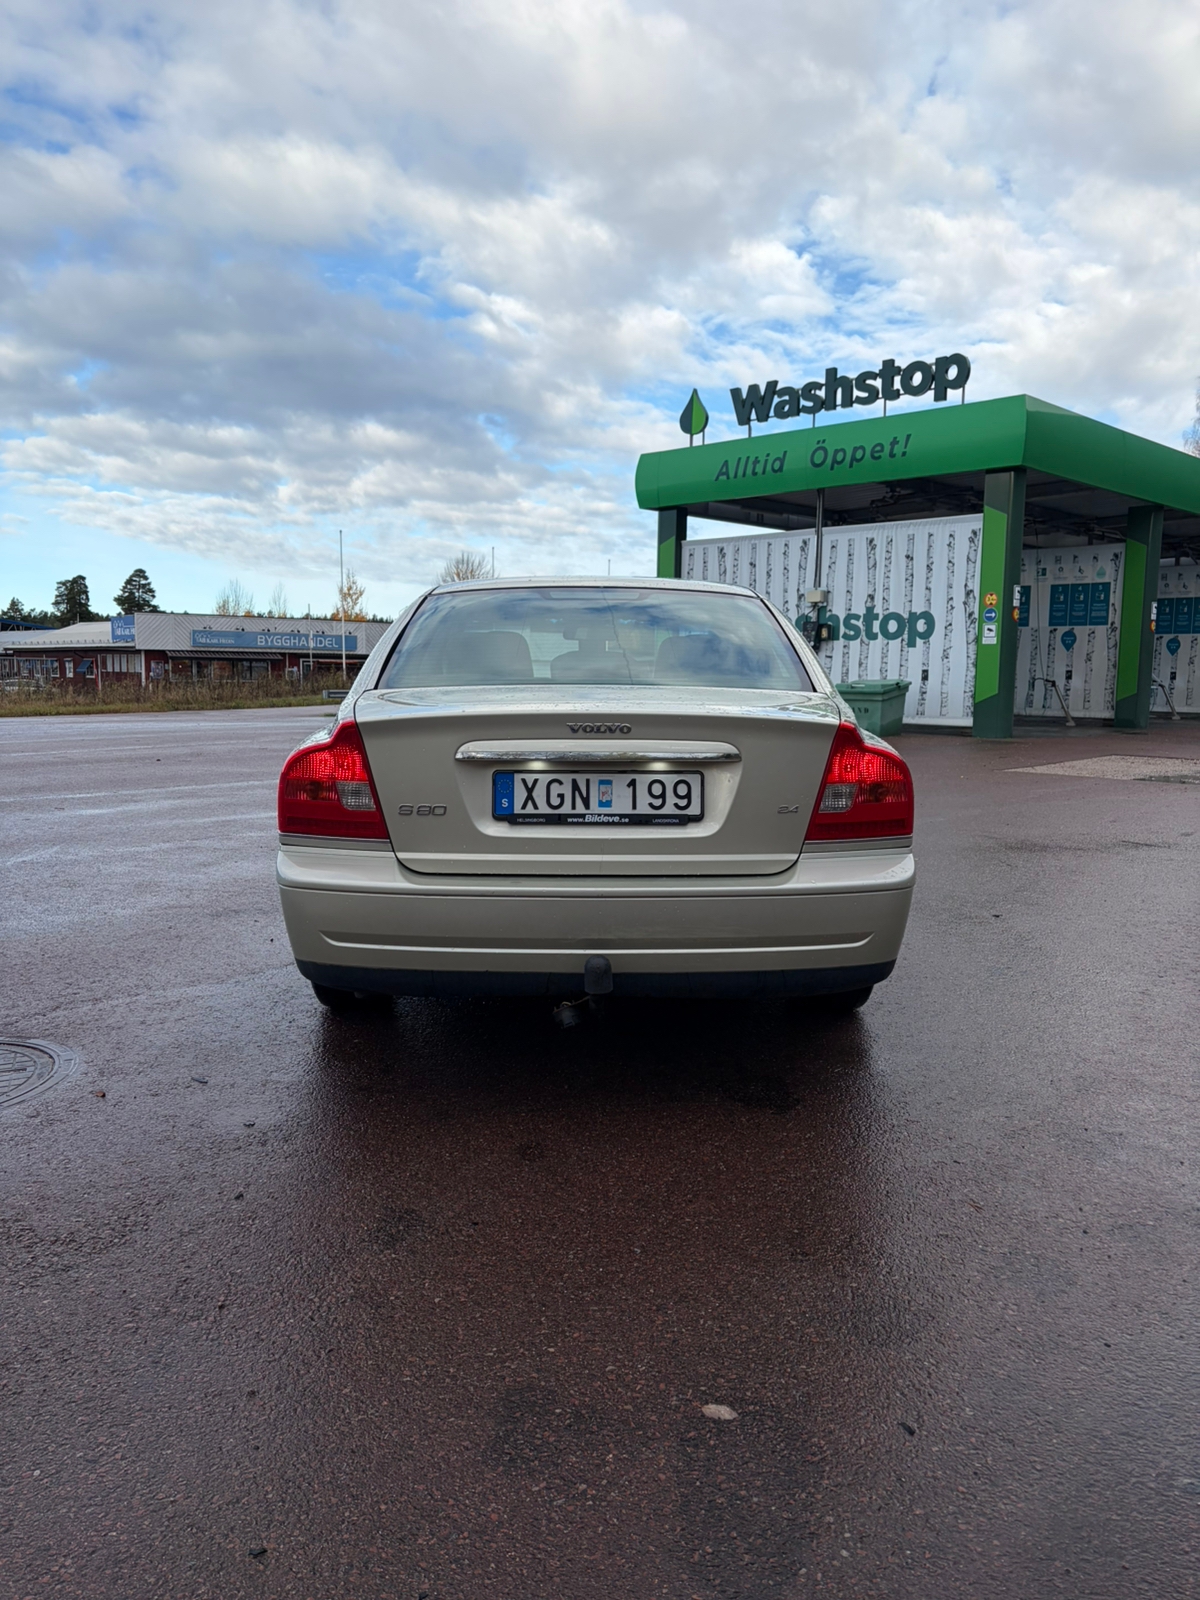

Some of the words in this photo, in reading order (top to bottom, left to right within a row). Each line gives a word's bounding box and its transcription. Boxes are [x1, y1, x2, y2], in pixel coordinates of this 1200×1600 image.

[730, 353, 971, 426] Washstop
[714, 450, 788, 482] Alltid
[809, 433, 912, 471] Öppet!
[257, 634, 339, 648] BYGGHANDEL
[566, 722, 632, 734] VOLVO
[520, 778, 591, 810] XGN
[626, 778, 692, 811] 199
[501, 798, 509, 808] S
[567, 814, 630, 823] www.Bildeve.se
